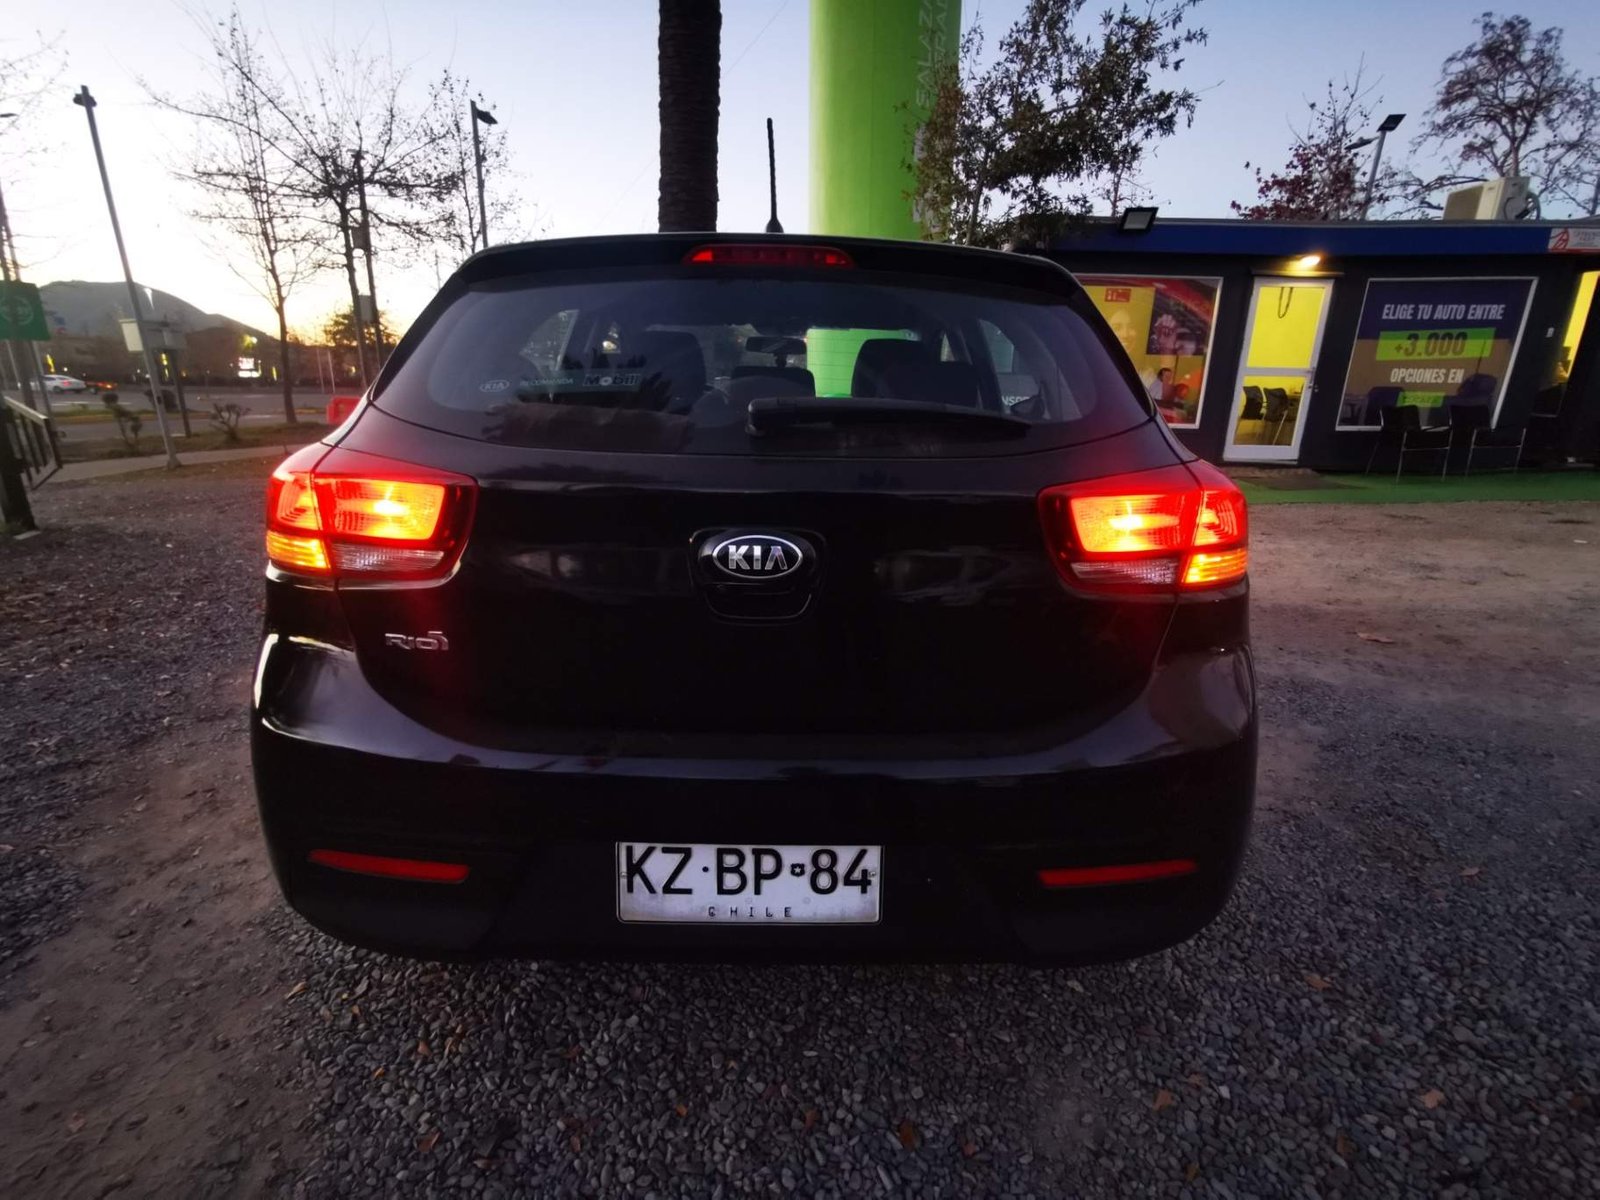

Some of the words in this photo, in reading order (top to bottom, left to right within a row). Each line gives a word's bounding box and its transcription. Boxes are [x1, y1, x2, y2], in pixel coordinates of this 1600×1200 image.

[1382, 304, 1415, 320] ELIGE
[1417, 304, 1433, 320] TU
[1433, 304, 1466, 320] AUTO
[1467, 304, 1506, 320] ENTRE
[1395, 332, 1468, 357] +3.000
[1390, 368, 1445, 383] OPCIONES
[1447, 369, 1464, 384] EN
[727, 544, 789, 571] KIA
[708, 905, 793, 919] CHILE
